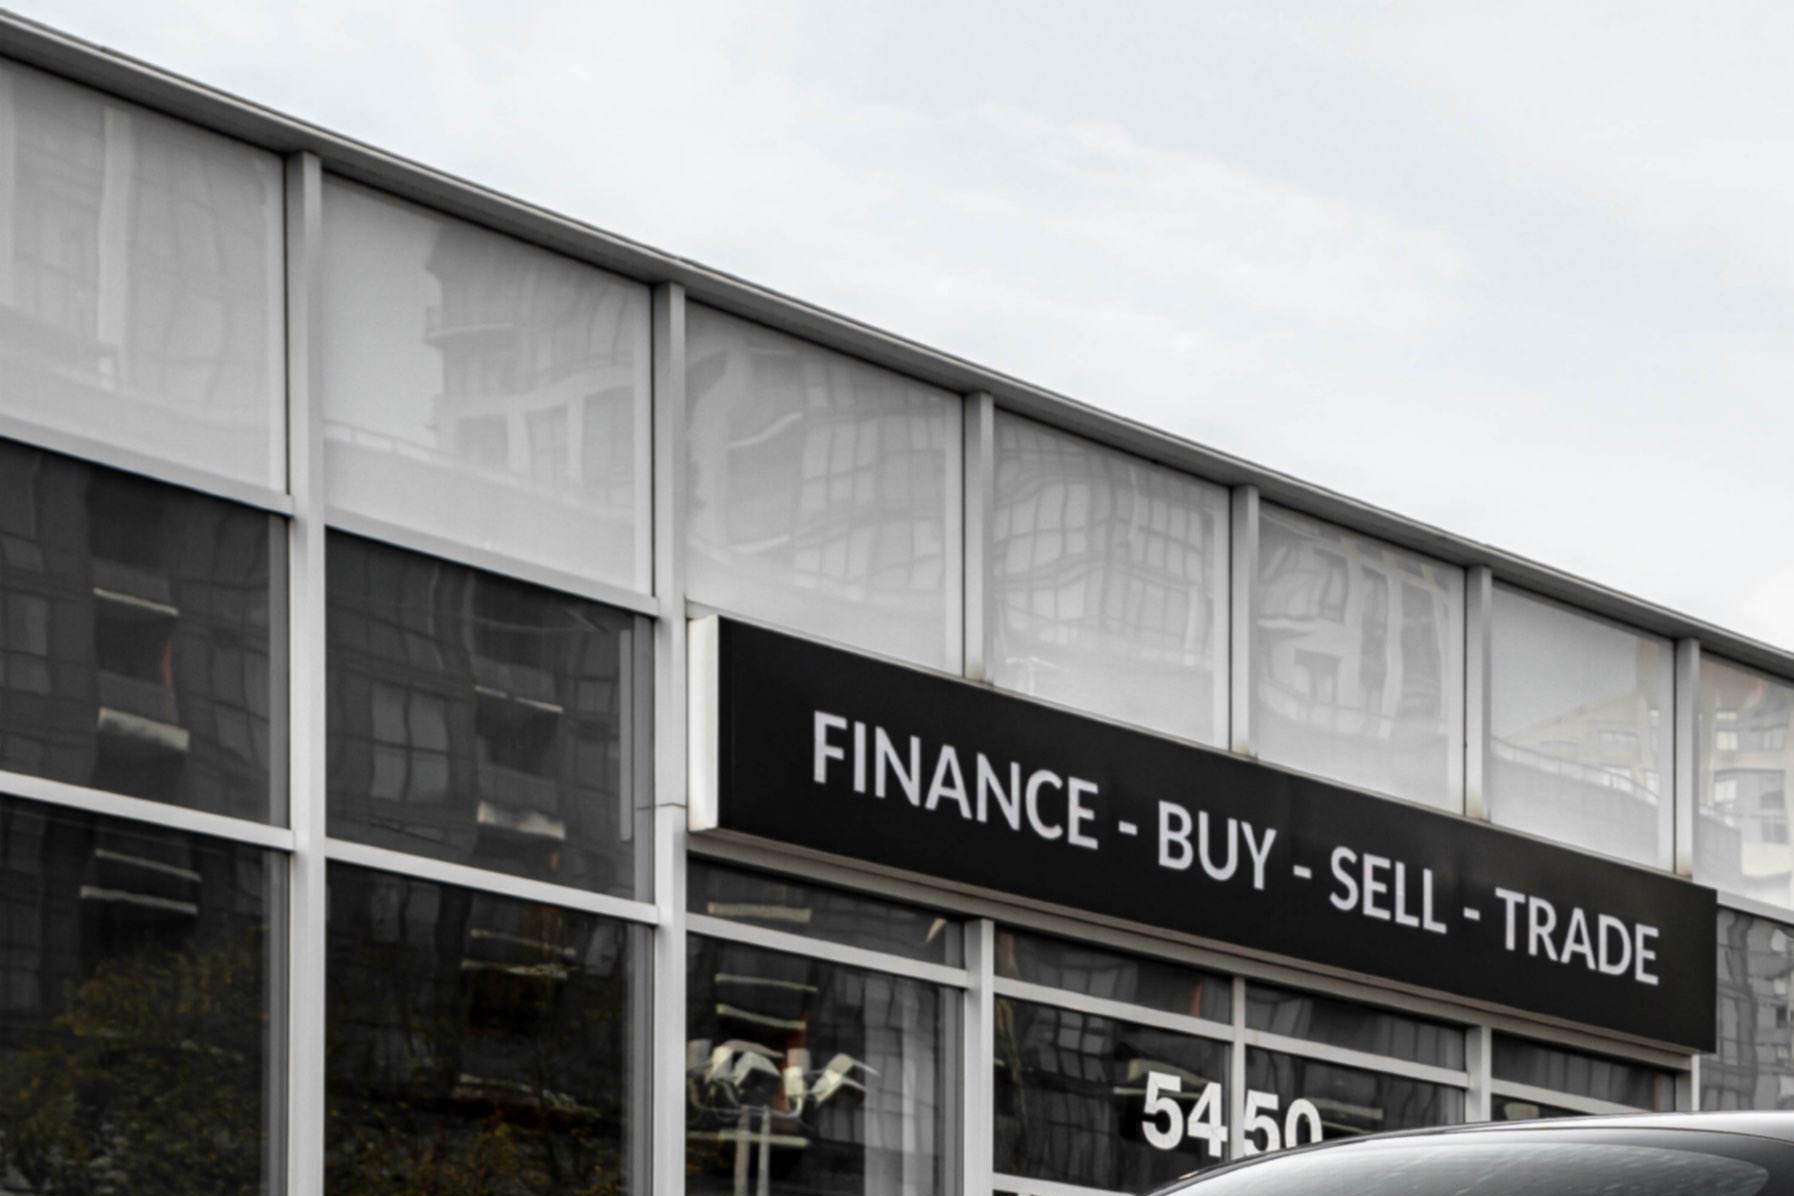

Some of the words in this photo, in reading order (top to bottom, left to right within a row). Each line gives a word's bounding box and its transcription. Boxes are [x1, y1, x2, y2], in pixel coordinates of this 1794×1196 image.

[814, 711, 1099, 850] FINANCE
[1158, 800, 1278, 890] BUY
[1329, 846, 1447, 934] SELL
[1495, 887, 1659, 985] TRADE
[1142, 1070, 1324, 1158] 5450
